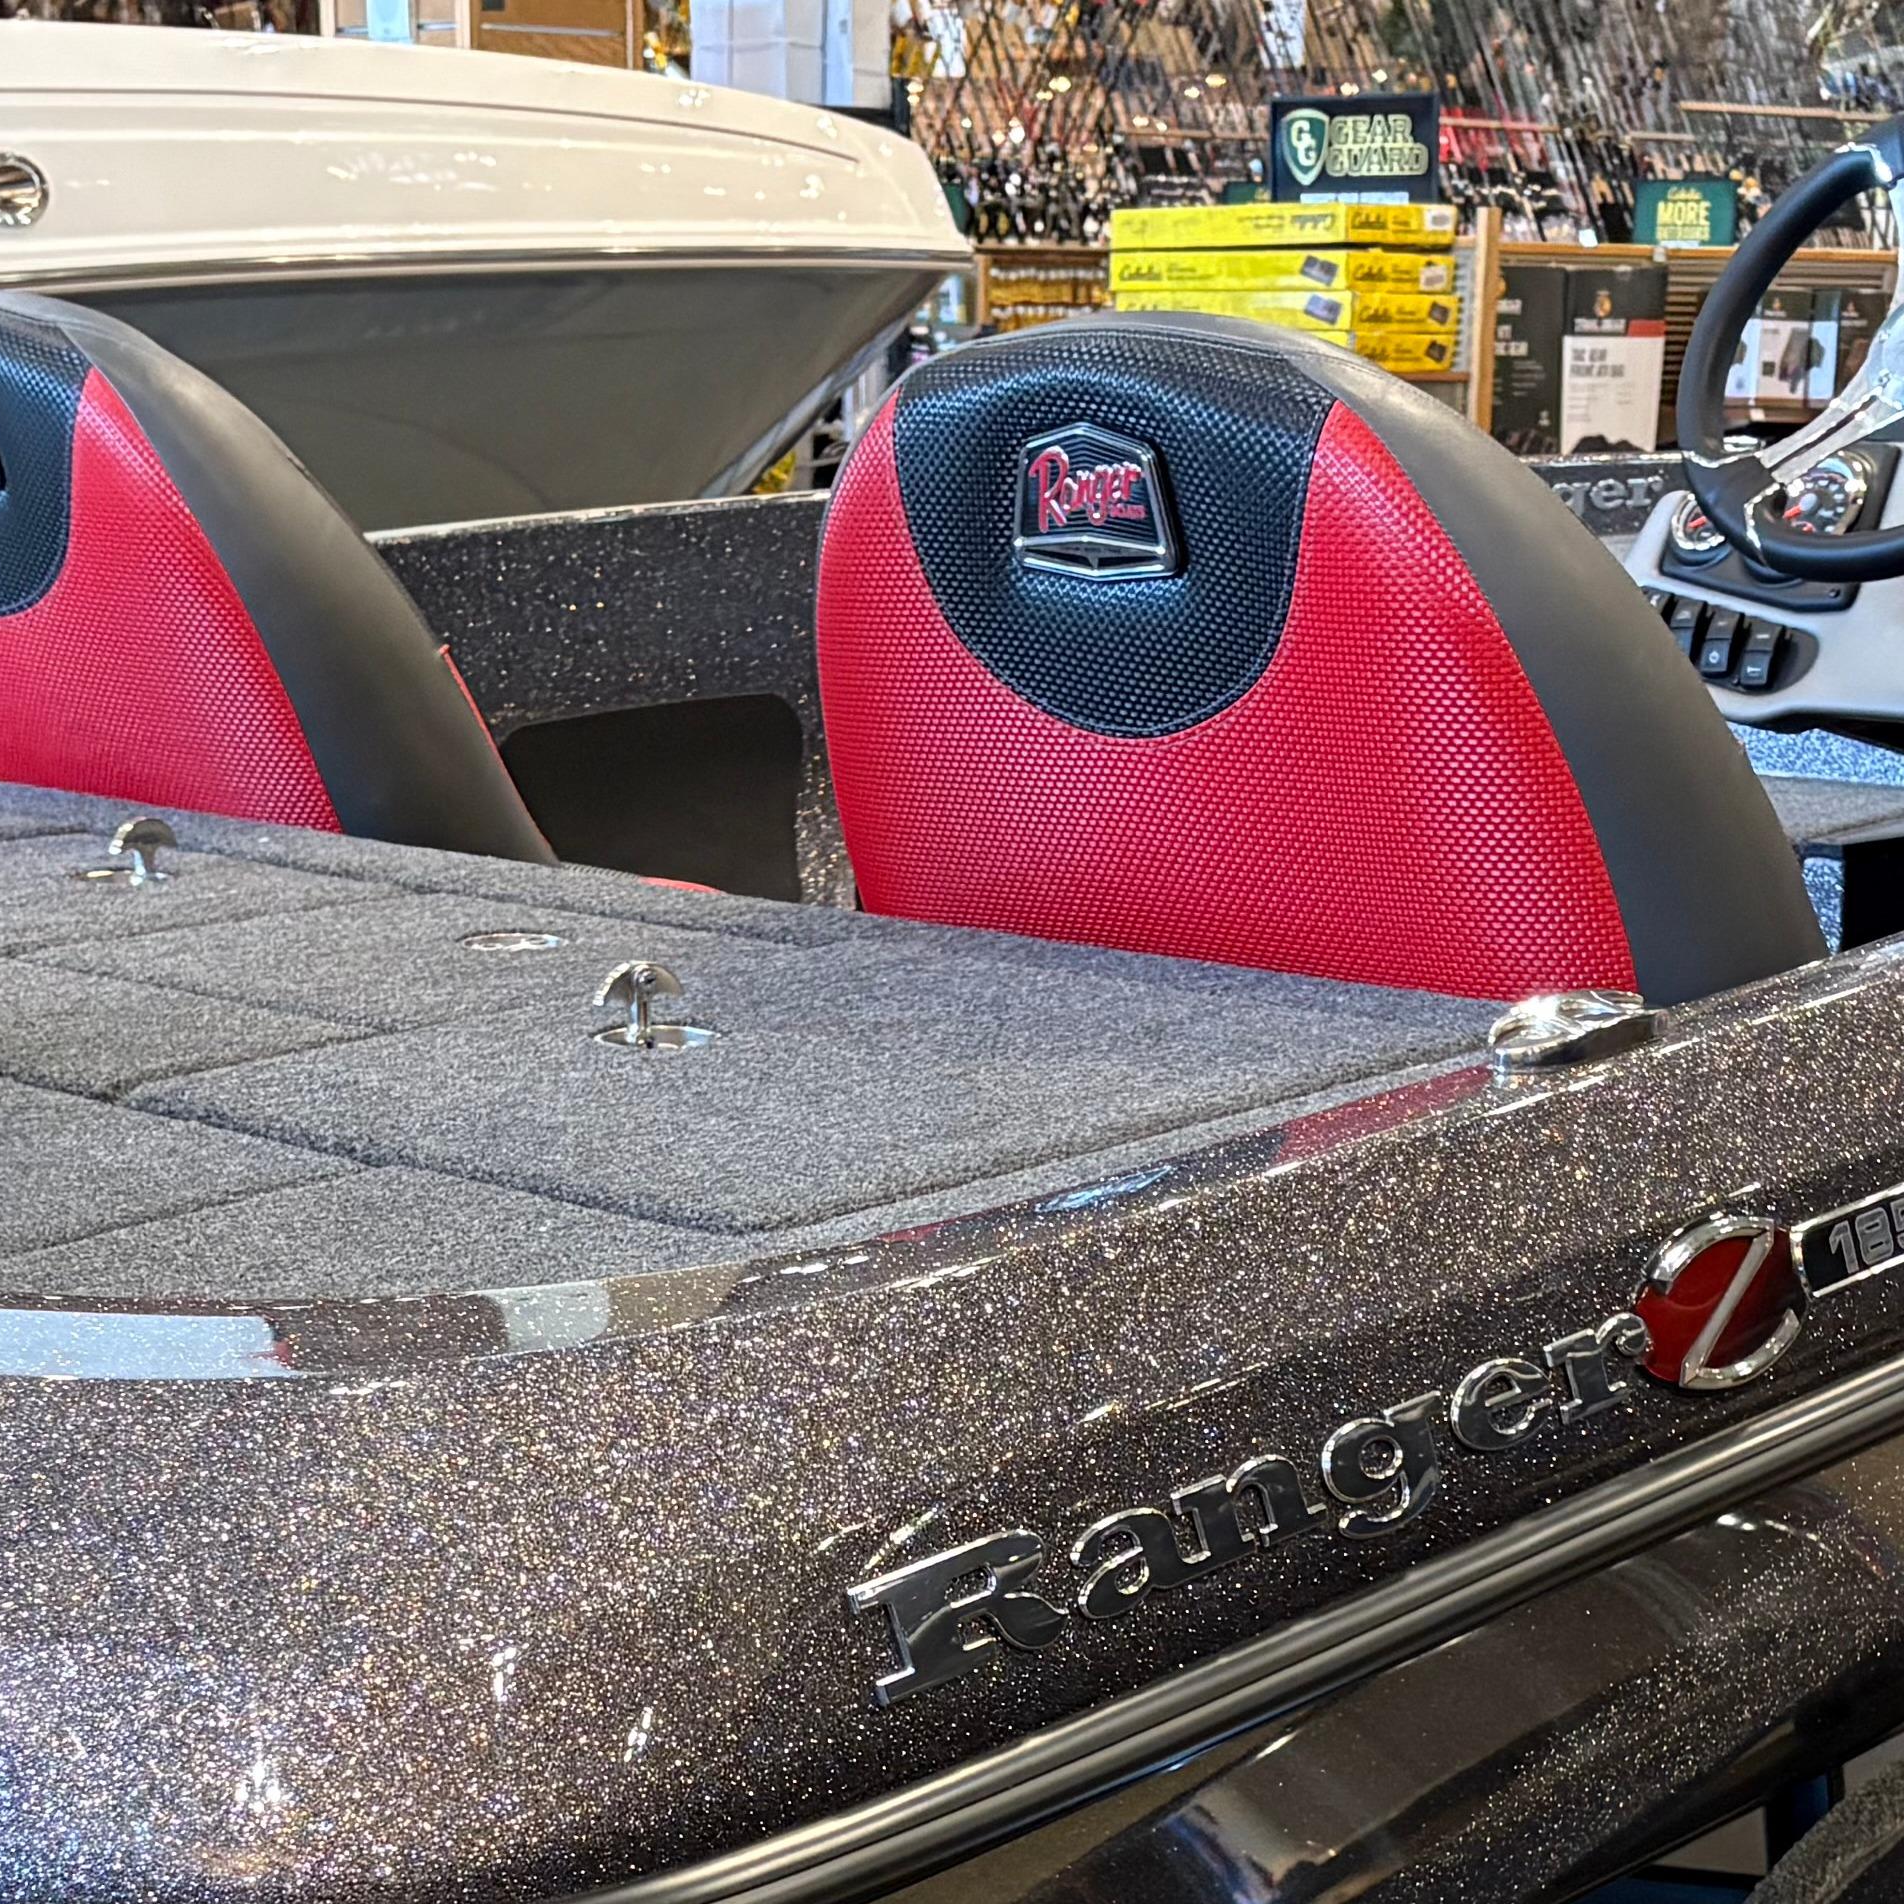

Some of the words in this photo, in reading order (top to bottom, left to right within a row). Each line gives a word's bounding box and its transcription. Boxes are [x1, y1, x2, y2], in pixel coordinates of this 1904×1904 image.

[1329, 114, 1414, 145] GEAR
[1326, 143, 1429, 177] GUARD
[1656, 200, 1712, 226] MORE
[1027, 444, 1144, 534] Ranger
[846, 1311, 1655, 1706] Ranger
